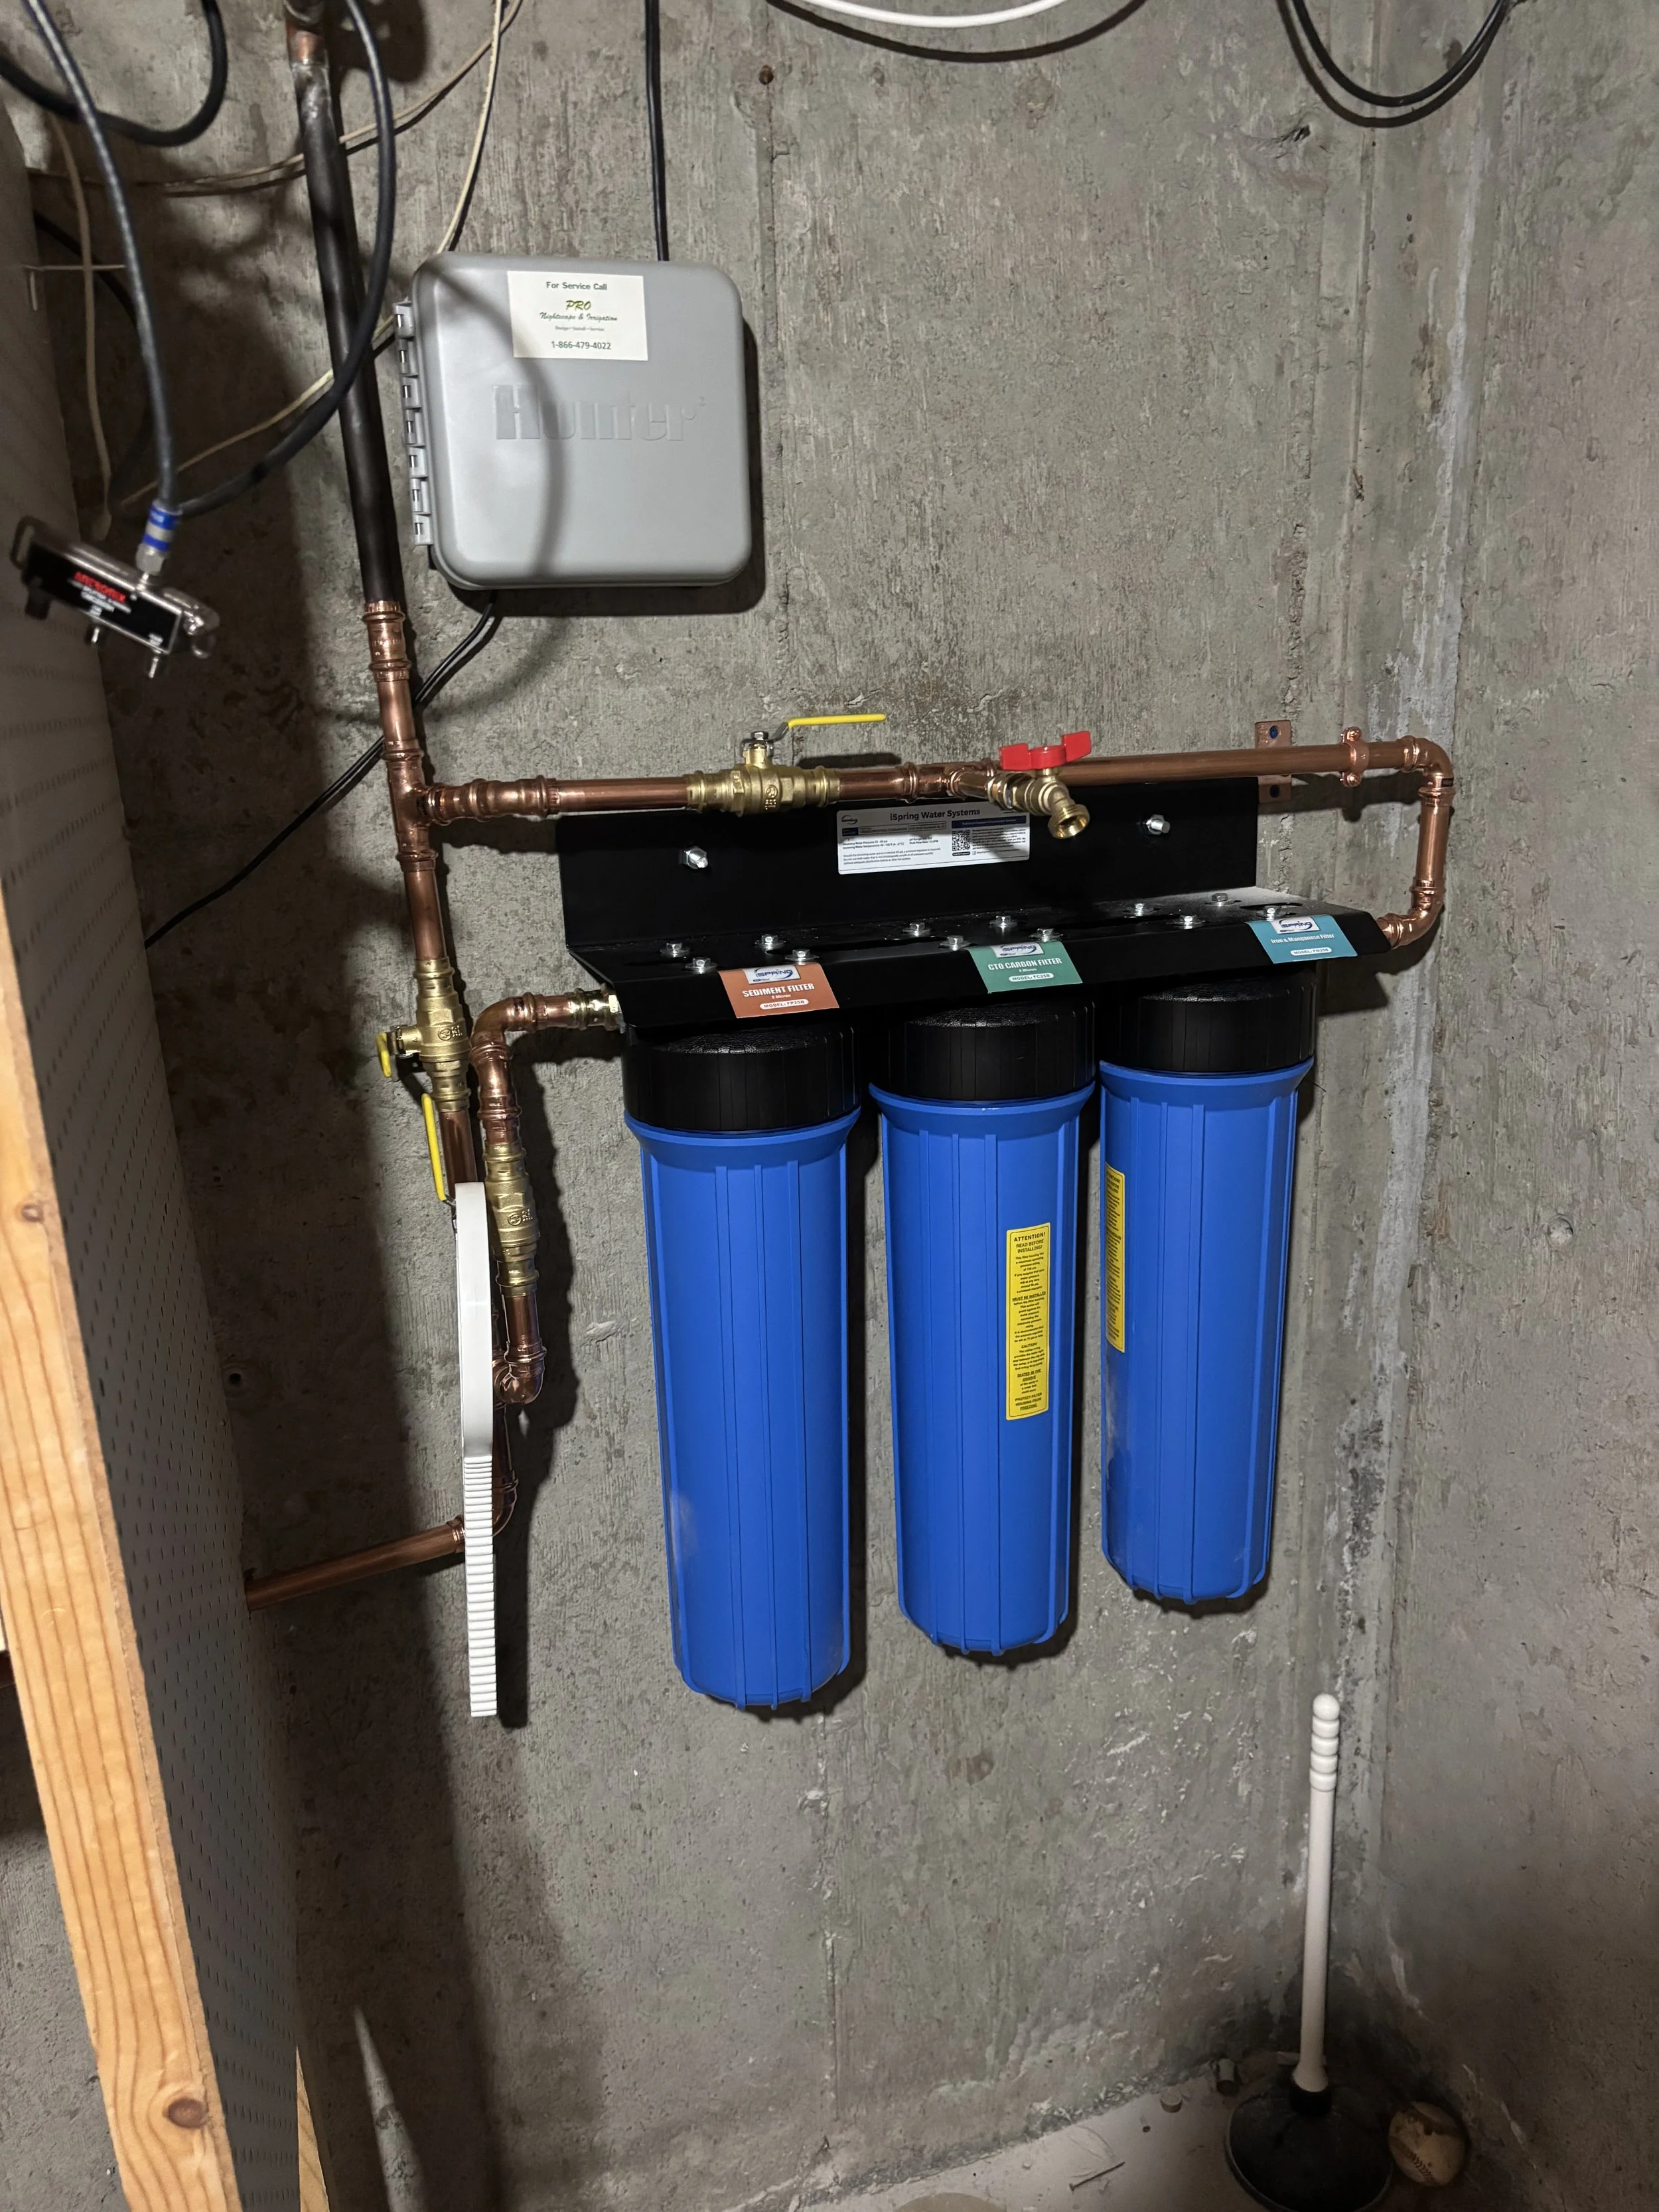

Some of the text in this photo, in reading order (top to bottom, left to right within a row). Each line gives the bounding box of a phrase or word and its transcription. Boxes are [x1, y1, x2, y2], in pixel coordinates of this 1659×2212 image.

[565, 300, 592, 311] PRO
[551, 341, 611, 350] 1-866-479-4022
[890, 813, 919, 822] iSpring
[947, 808, 980, 818] Systems
[743, 983, 815, 997] SEDIMENT FILTER
[1014, 1232, 1045, 1242] ATTENTION!
